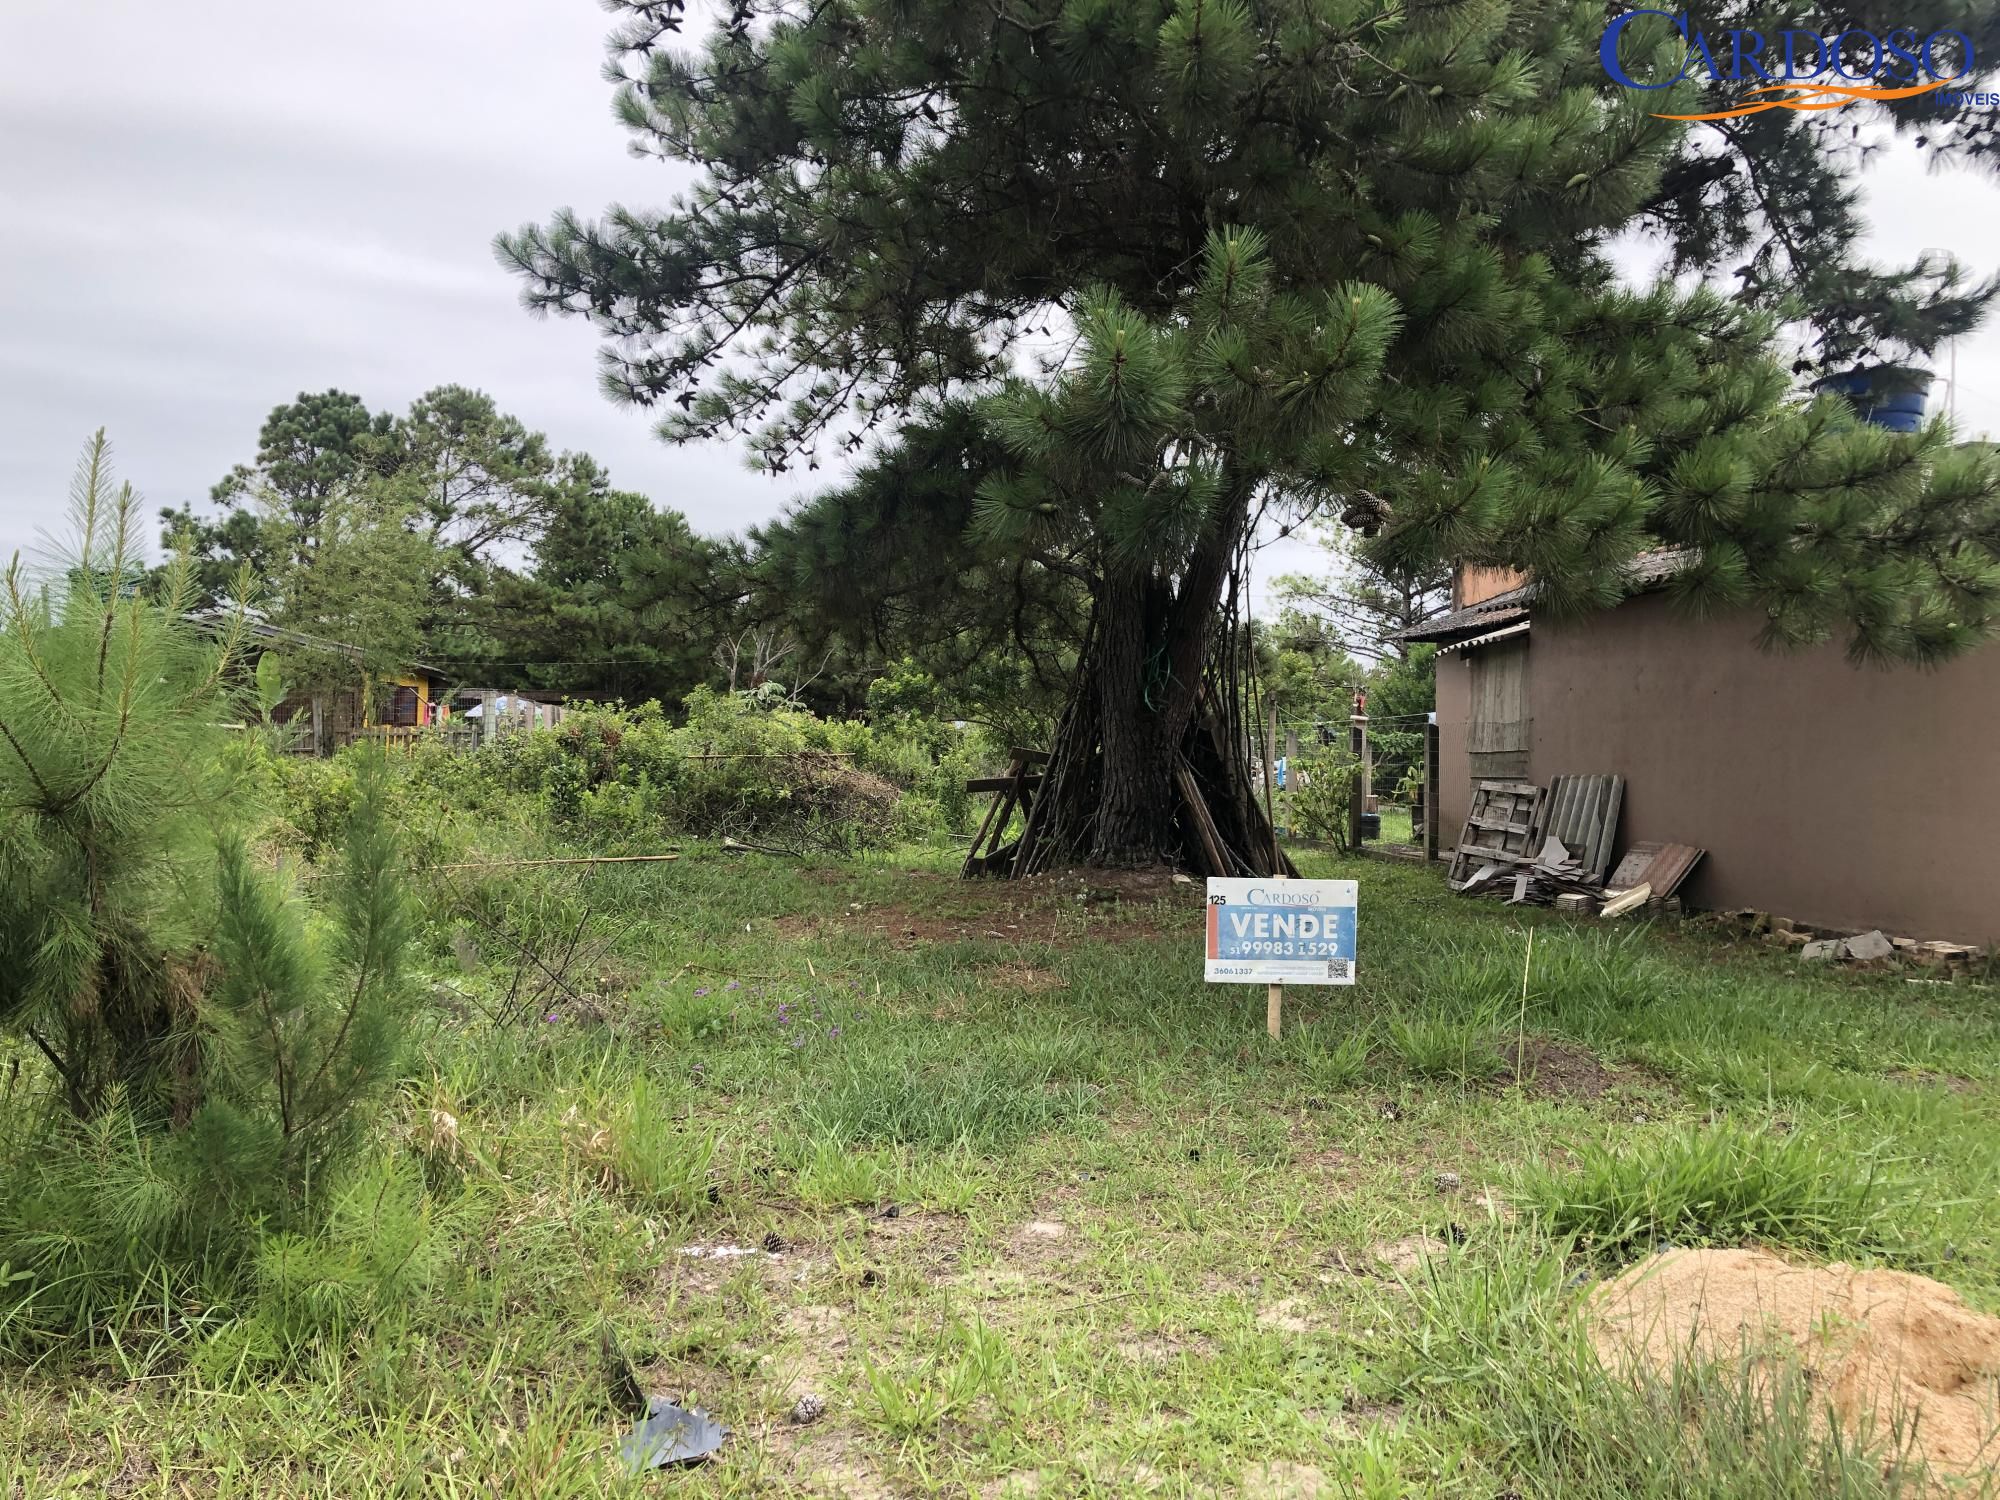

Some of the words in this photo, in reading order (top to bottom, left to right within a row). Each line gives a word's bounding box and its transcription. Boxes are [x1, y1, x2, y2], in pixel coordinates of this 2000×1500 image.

[1209, 895, 1226, 905] 125
[1247, 888, 1319, 905] CARDOSO
[1230, 912, 1339, 939] VENDE
[1241, 941, 1294, 956] 99983
[1298, 942, 1338, 956] 1529
